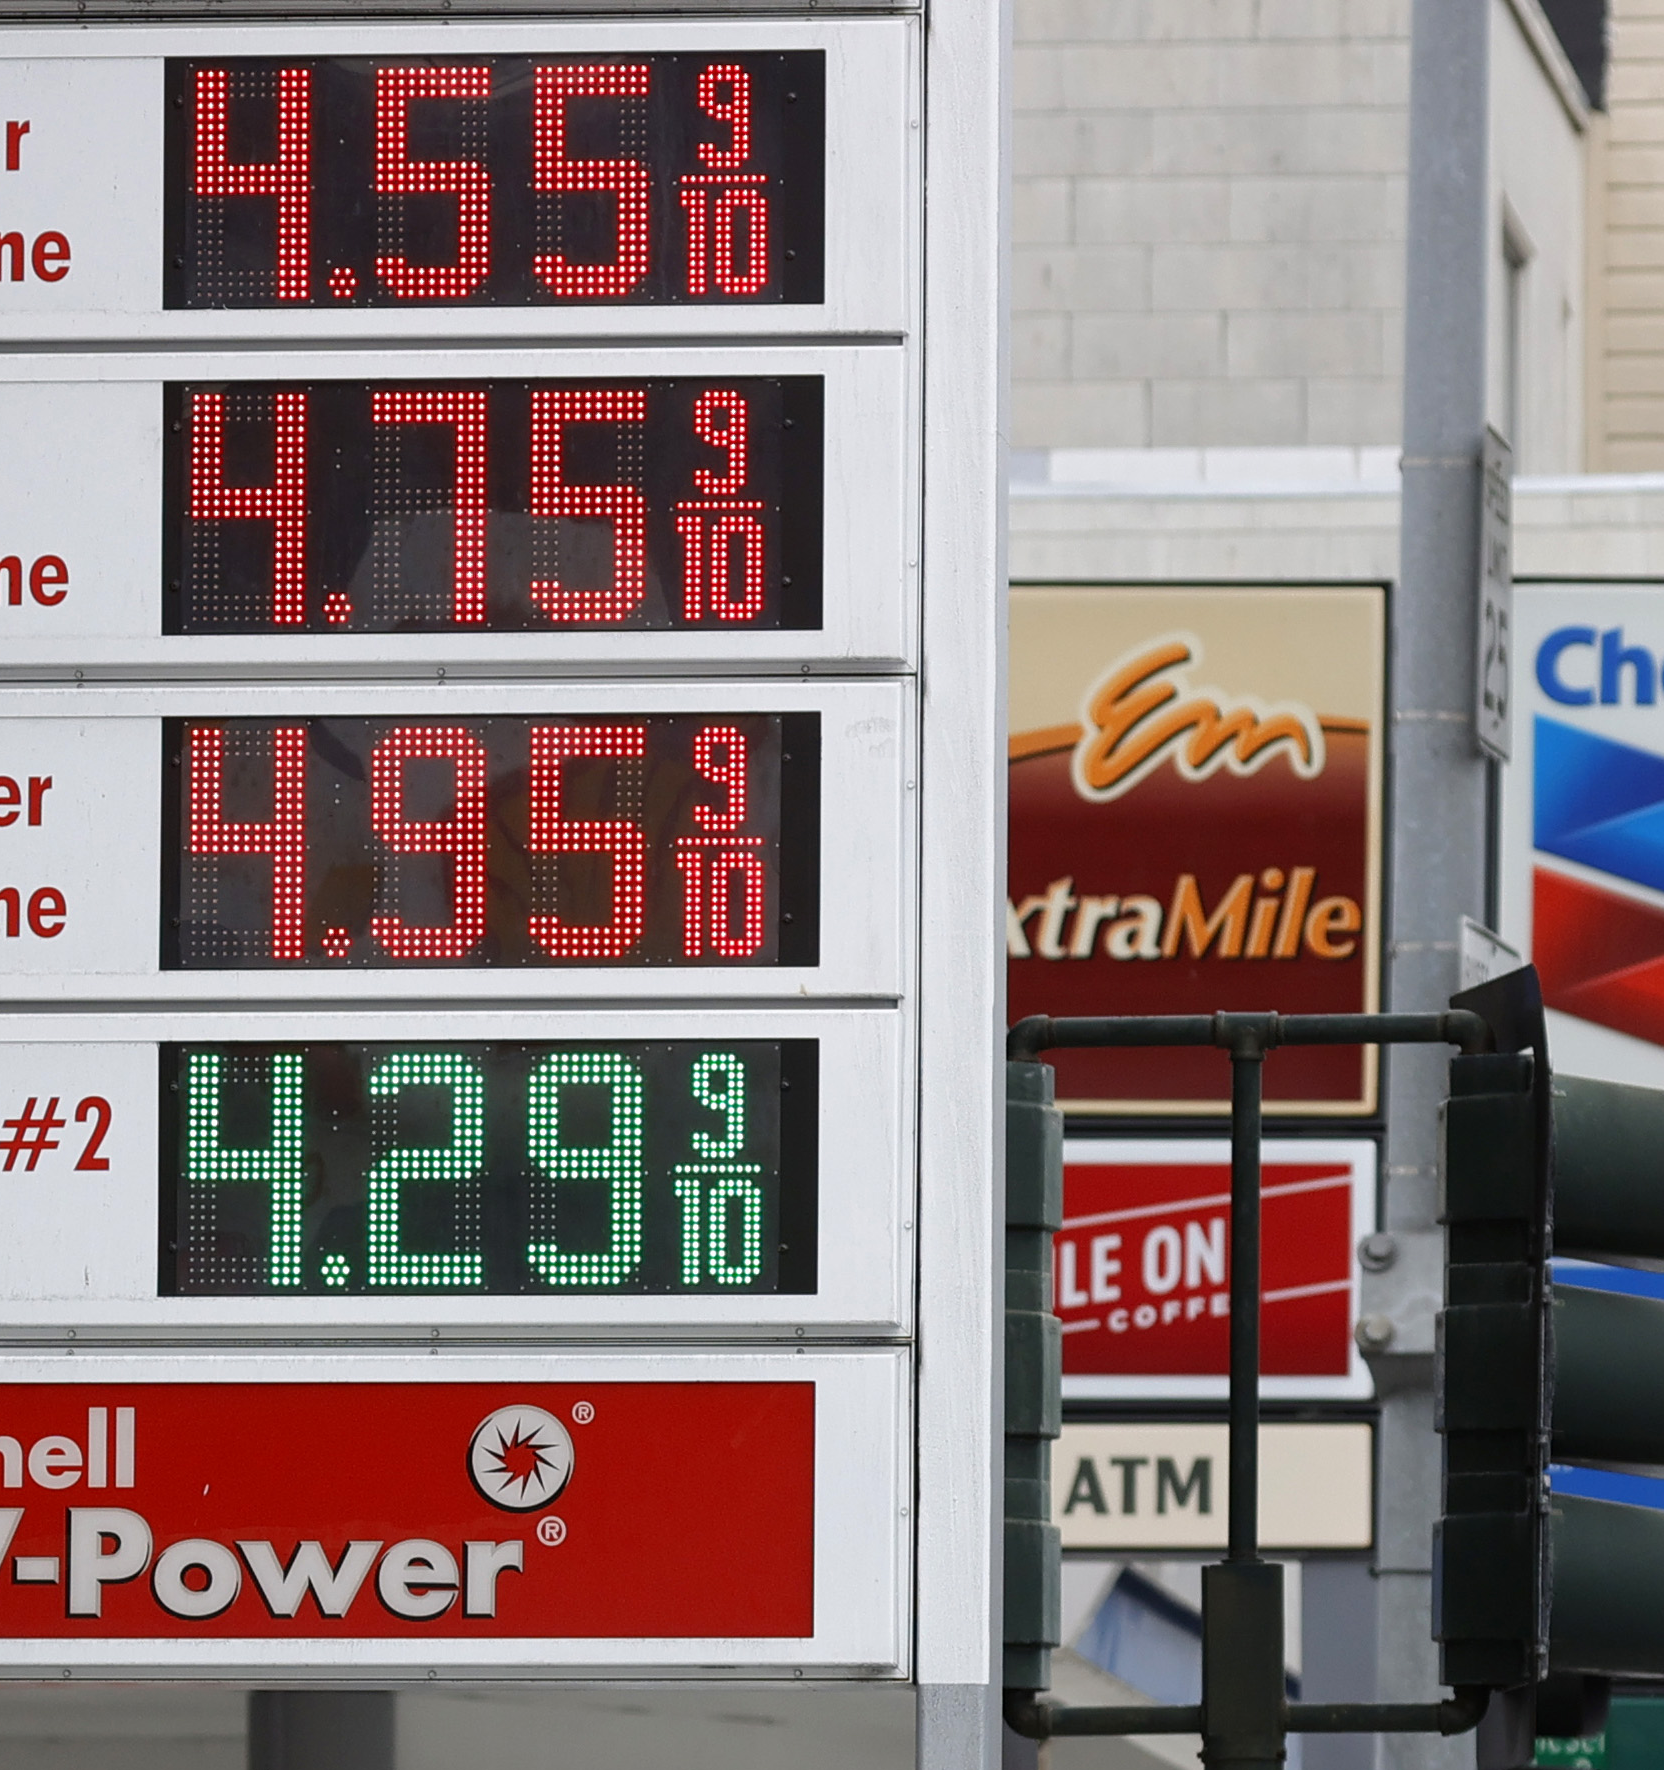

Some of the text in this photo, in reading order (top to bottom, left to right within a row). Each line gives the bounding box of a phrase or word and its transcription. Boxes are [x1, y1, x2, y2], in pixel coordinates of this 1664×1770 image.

[194, 64, 649, 299] 4.55
[190, 390, 646, 624] 4.75
[189, 725, 646, 960] 4.95
[187, 1052, 643, 1287] 4.29
[1053, 1217, 1227, 1308] LE ON
[1063, 1456, 1213, 1516] ATM
